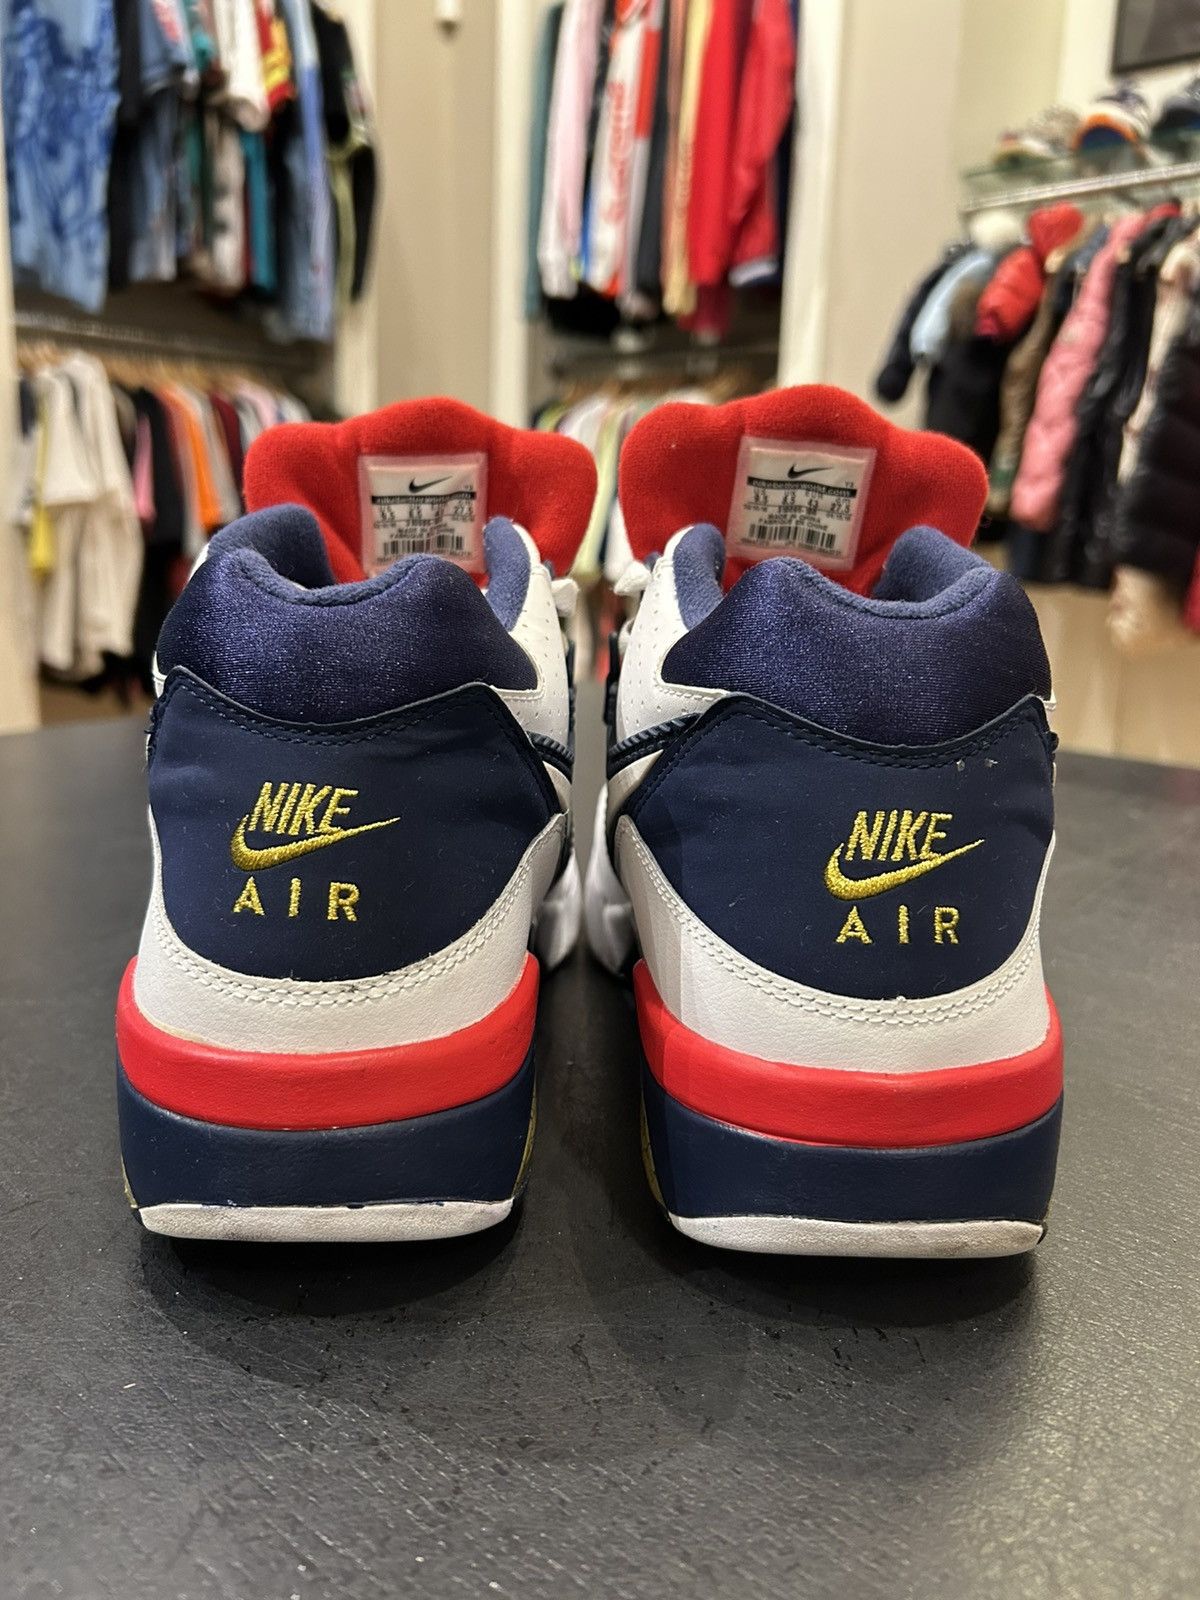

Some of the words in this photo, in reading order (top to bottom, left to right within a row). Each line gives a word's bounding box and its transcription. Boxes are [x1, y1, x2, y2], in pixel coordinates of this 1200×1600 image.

[248, 781, 359, 836] NIKE
[844, 809, 953, 861] NIKE
[232, 876, 360, 922] AIR
[835, 904, 960, 944] AIR
